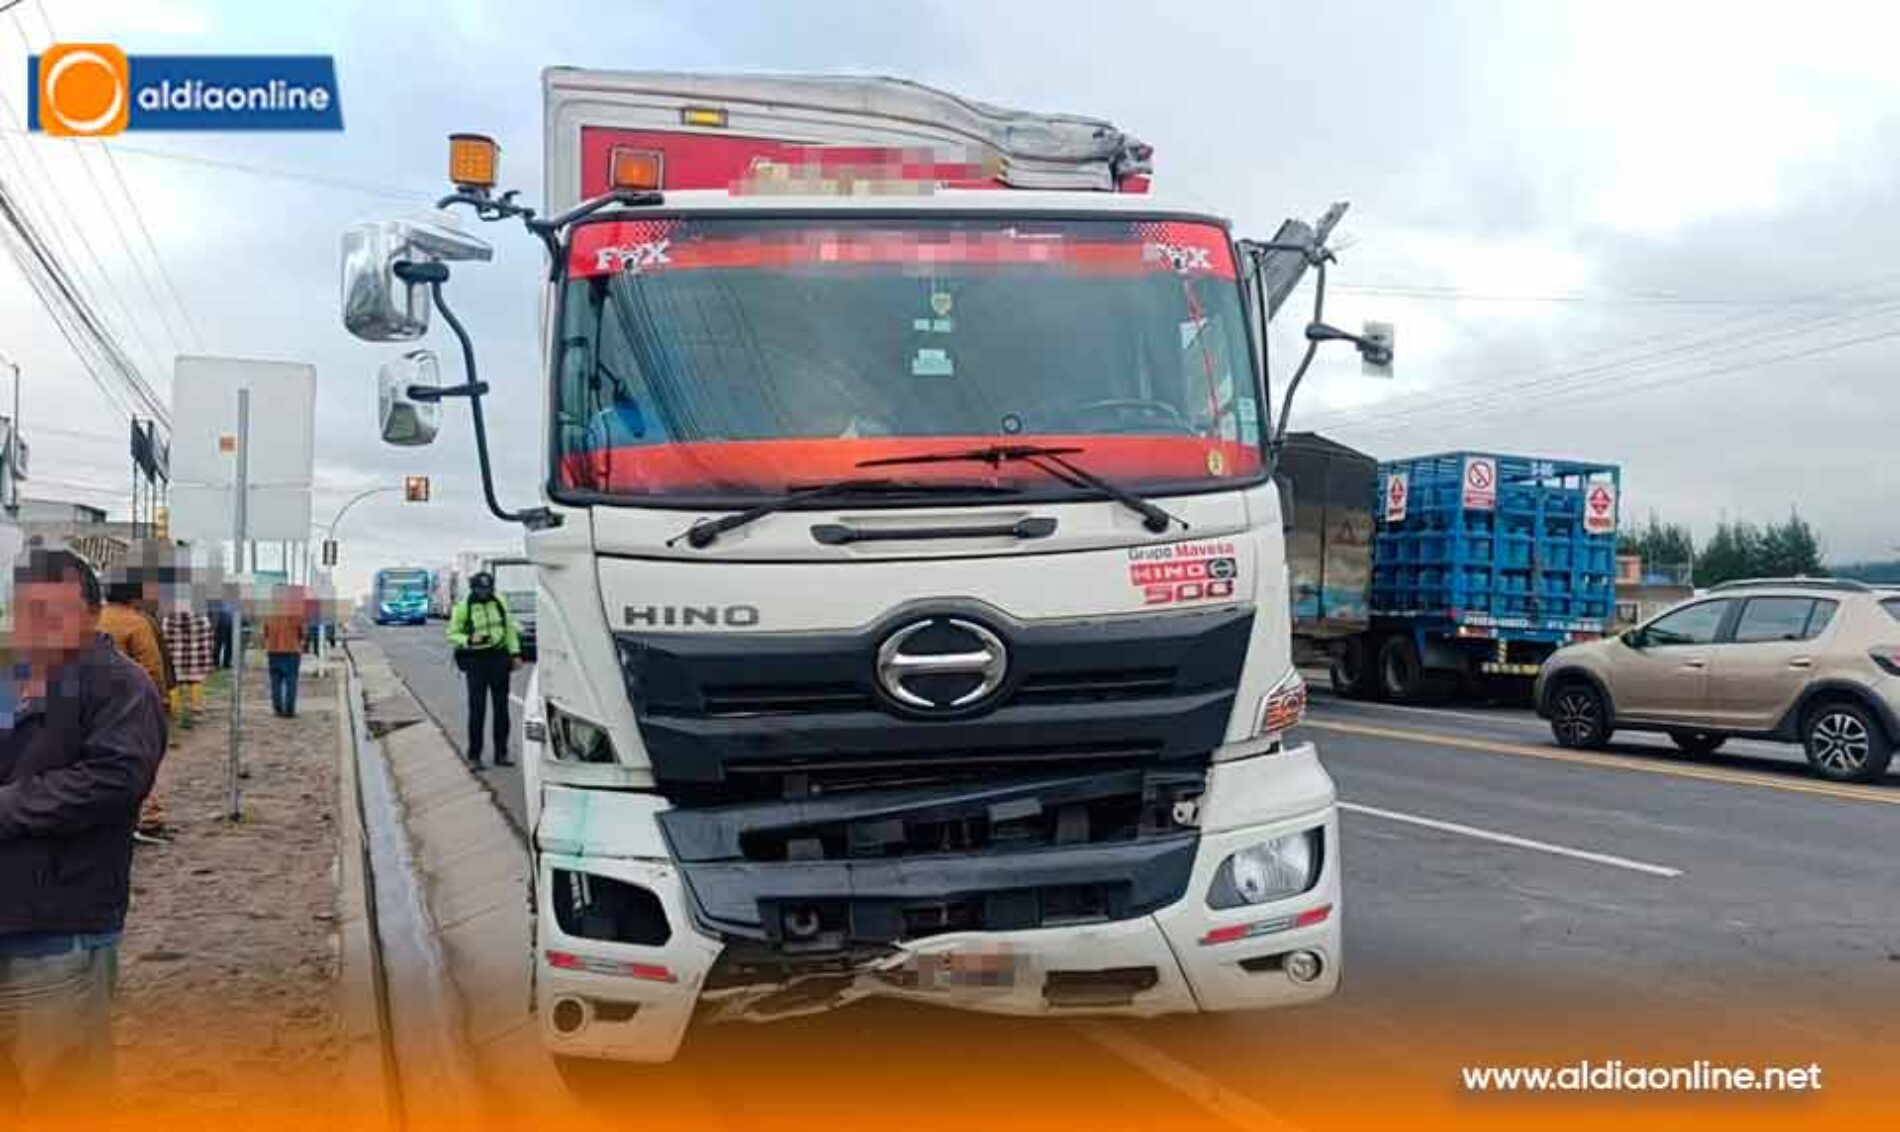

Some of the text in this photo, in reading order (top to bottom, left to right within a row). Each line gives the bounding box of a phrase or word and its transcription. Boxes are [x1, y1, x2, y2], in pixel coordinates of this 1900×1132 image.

[1128, 542, 1234, 561] Grupo Mavesa
[1132, 560, 1206, 581] HINO
[1144, 579, 1234, 604] 500
[624, 605, 761, 627] HINO
